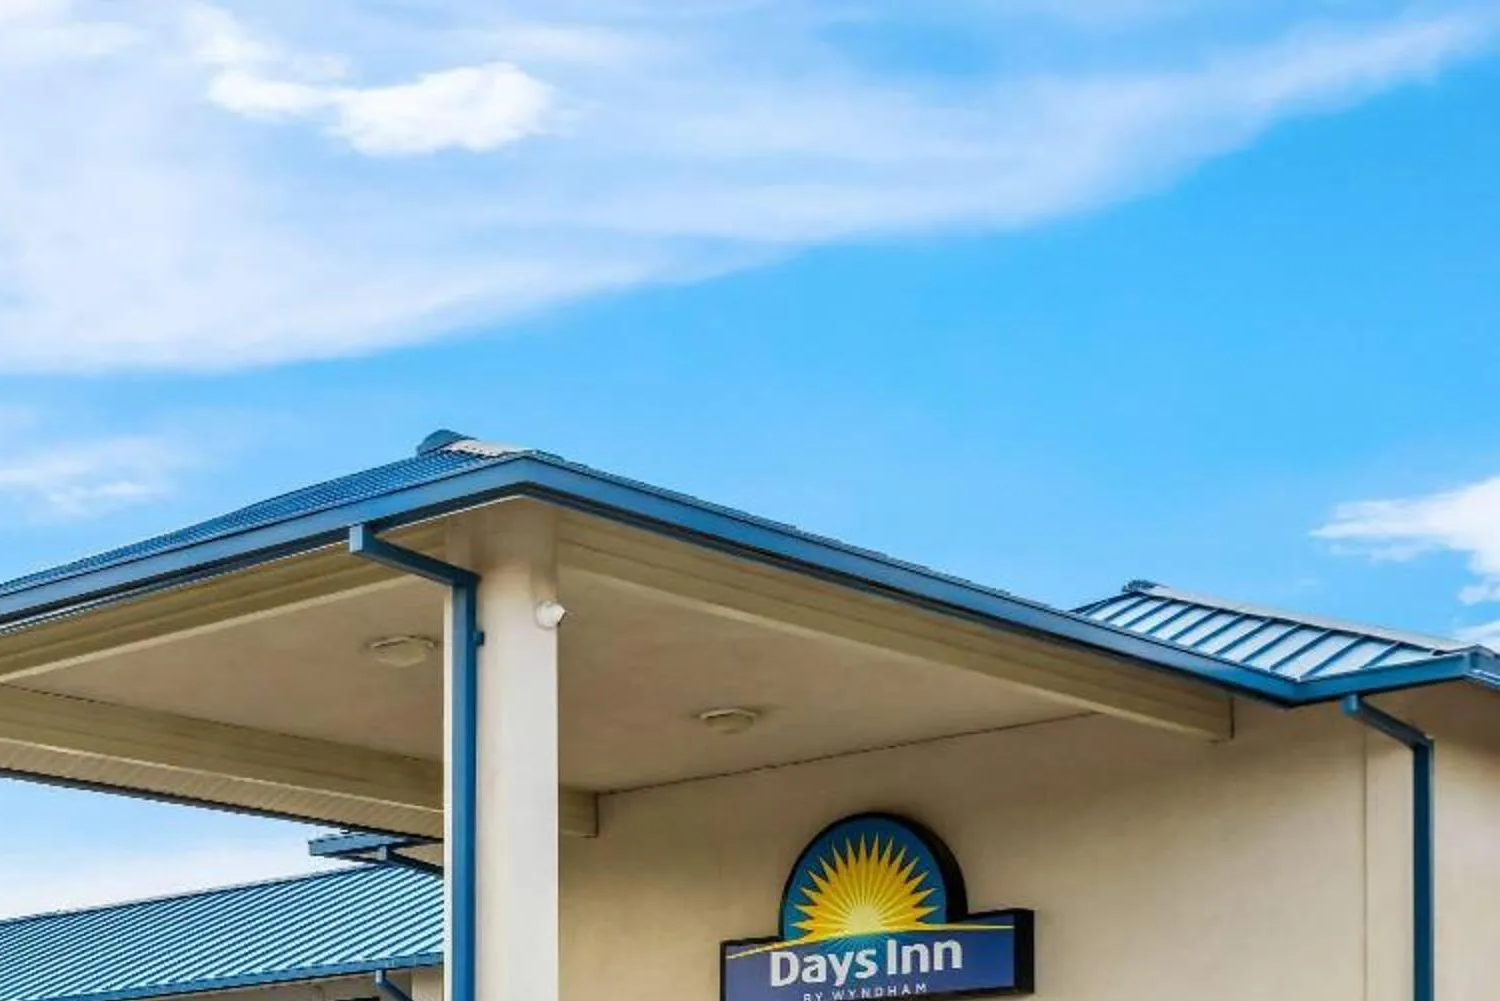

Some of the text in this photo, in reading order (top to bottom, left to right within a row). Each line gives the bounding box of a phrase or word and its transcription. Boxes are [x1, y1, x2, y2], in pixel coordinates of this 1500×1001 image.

[770, 938, 963, 987] Days Inn
[831, 982, 928, 1001] WYNDHAM
